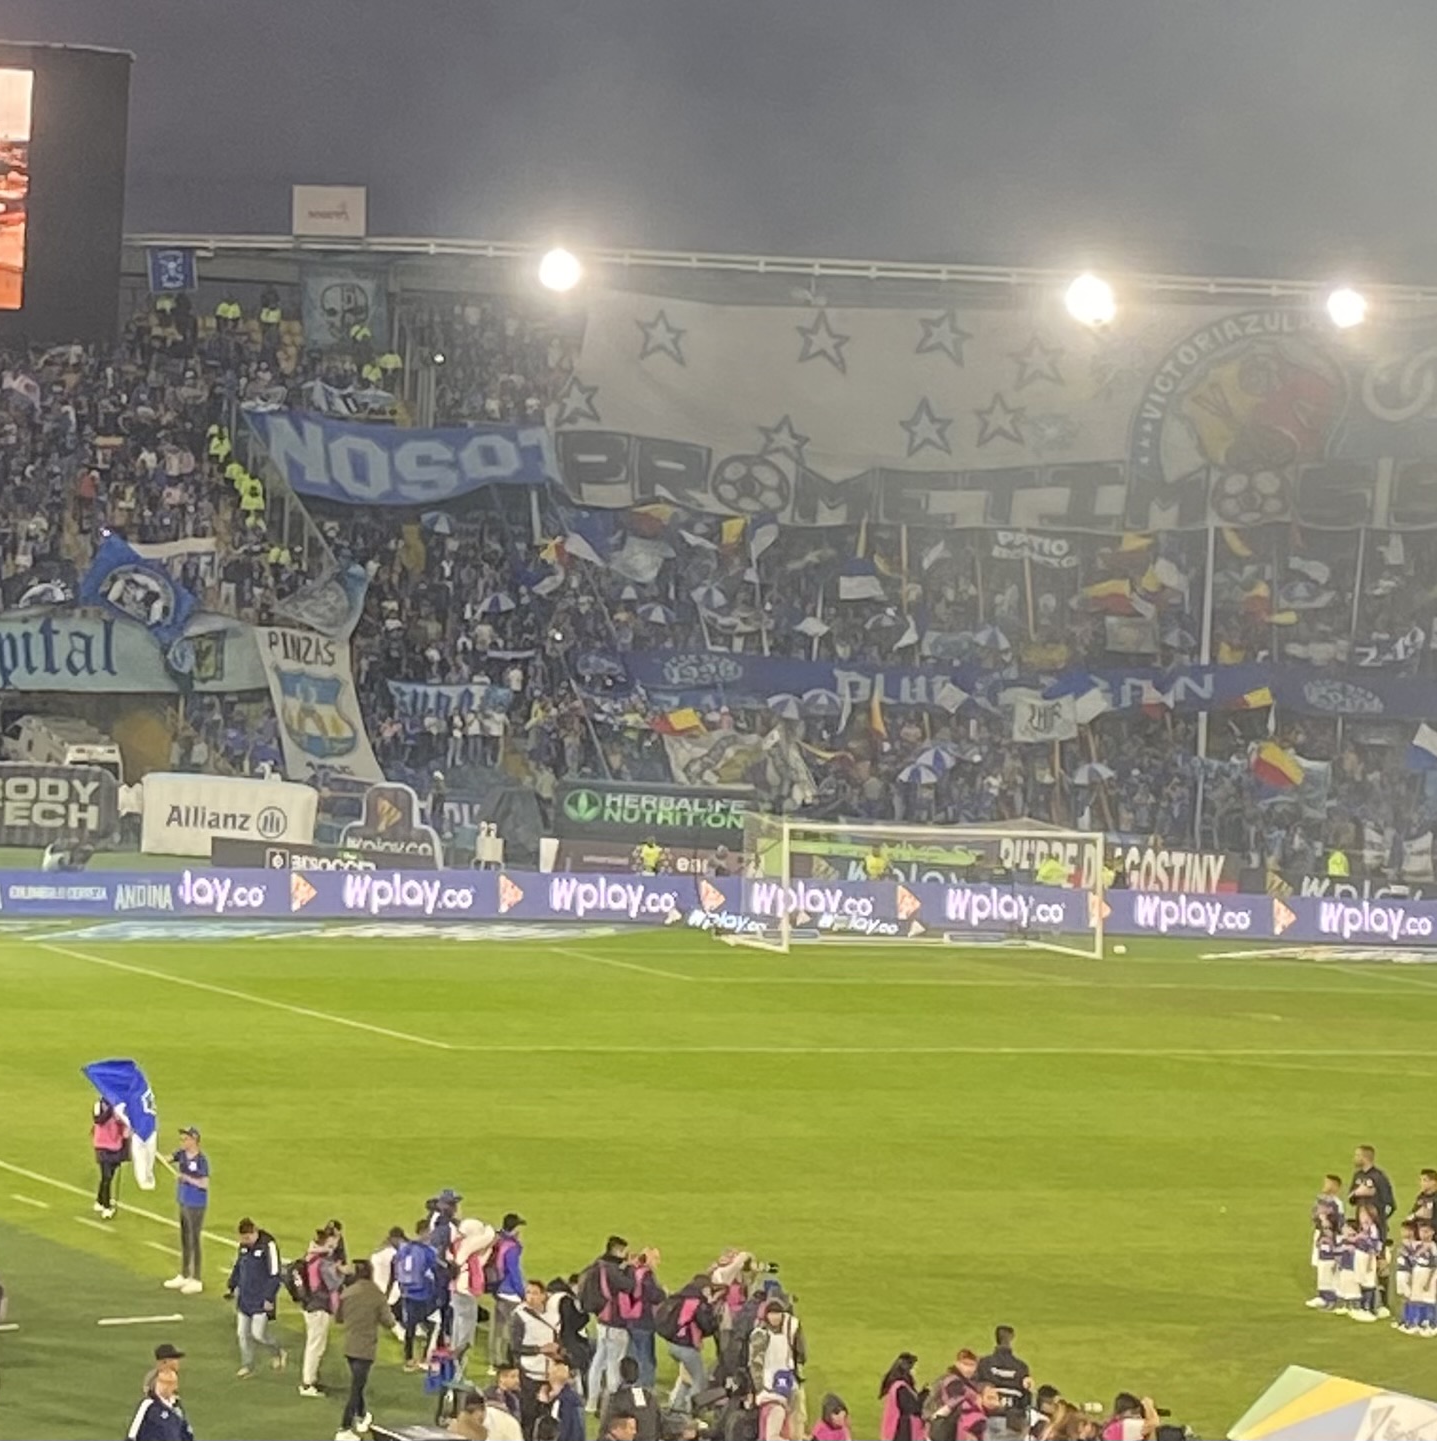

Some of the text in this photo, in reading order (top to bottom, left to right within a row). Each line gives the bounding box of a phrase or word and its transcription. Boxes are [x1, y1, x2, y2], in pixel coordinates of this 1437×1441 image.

[268, 630, 337, 666] PINZAS
[166, 804, 252, 831] Allianz
[603, 809, 744, 830] NUTRITION
[604, 793, 745, 815] HERBALIFE
[115, 883, 174, 911] ANDINA
[180, 869, 265, 913] lay.co
[344, 872, 473, 914] Wplay.co
[551, 877, 676, 919] Wplay.co
[1136, 894, 1250, 935] Wplay.co
[1320, 901, 1433, 941] Wplay.co
